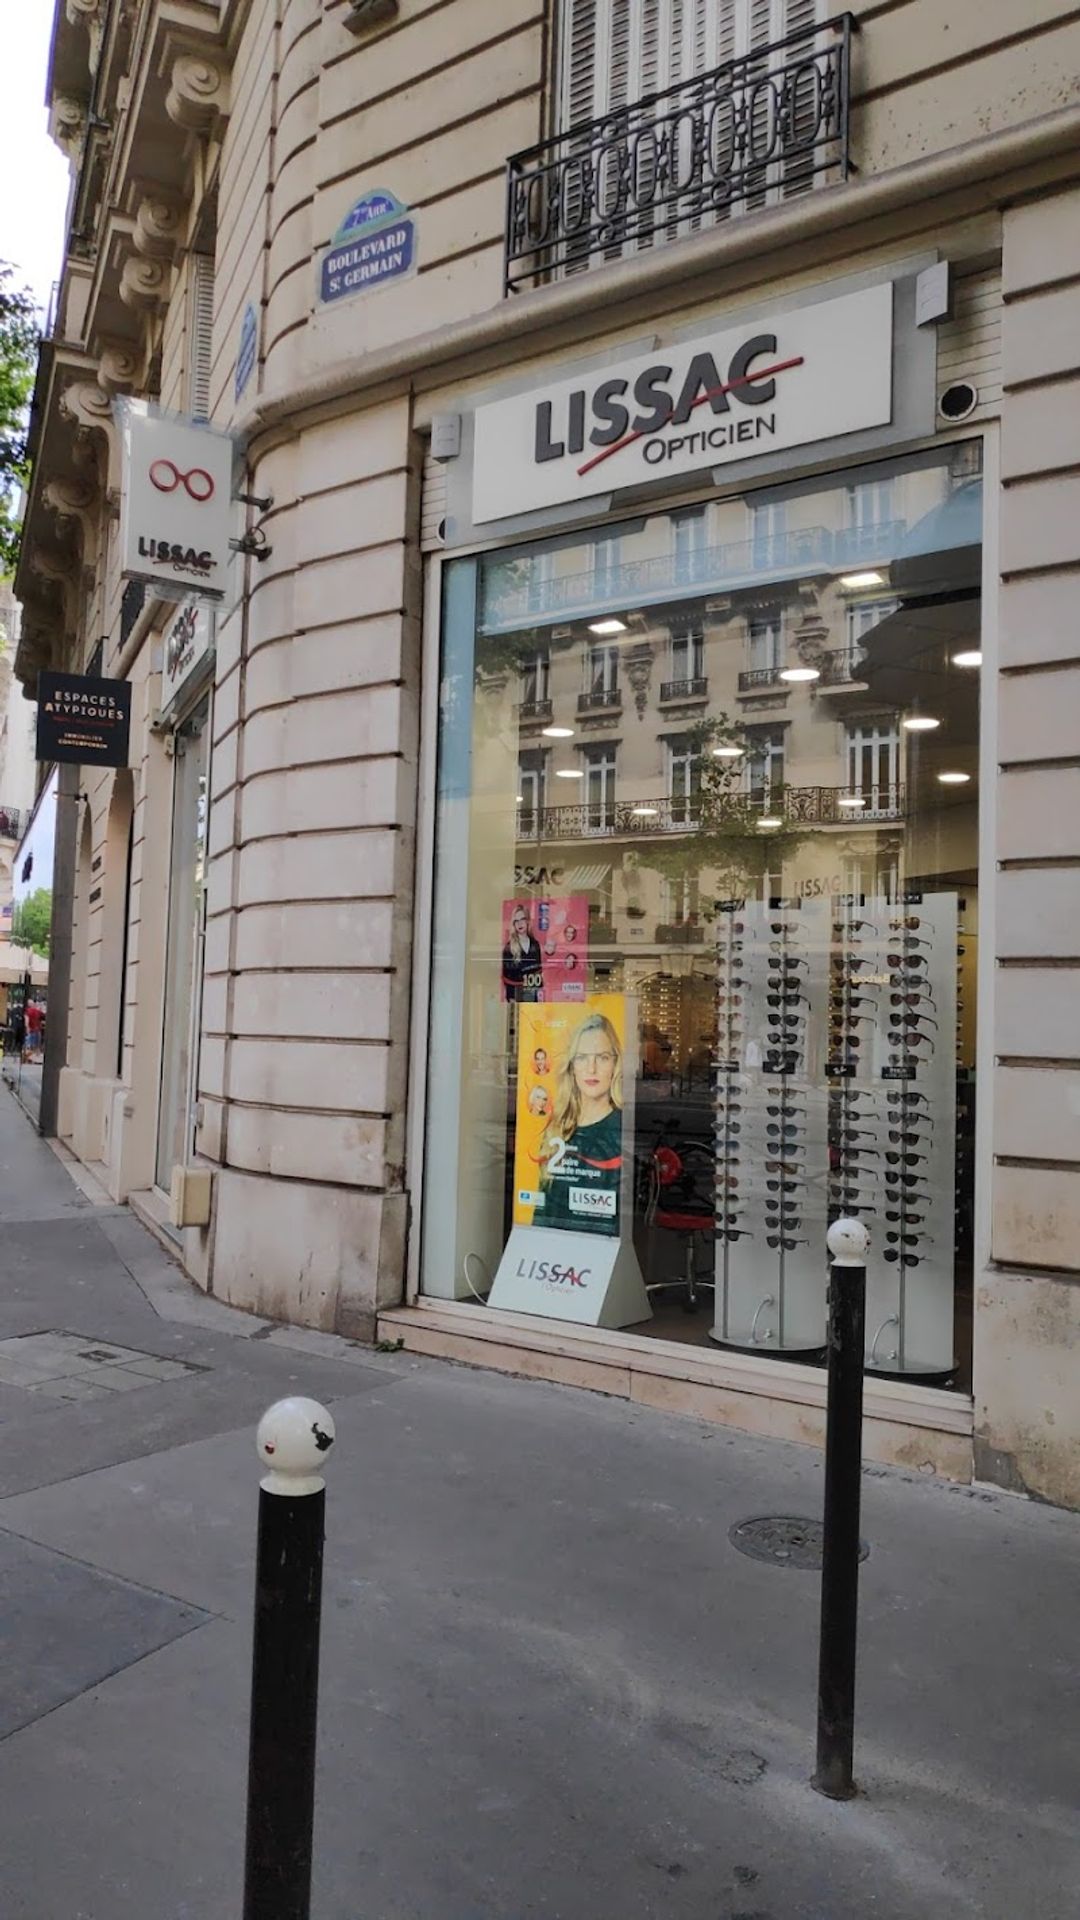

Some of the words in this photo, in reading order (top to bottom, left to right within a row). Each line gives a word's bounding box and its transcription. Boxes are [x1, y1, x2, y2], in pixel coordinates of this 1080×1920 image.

[328, 230, 406, 274] BOULEVARD
[344, 252, 402, 287] GERMAIN
[535, 334, 777, 463] LISSAC
[643, 414, 775, 464] OPTICIEN
[138, 536, 211, 570] LISSAC
[45, 702, 124, 720] ATYPIQUES
[55, 691, 115, 706] ESPACES
[573, 1192, 612, 1207] LISSAC
[516, 1258, 591, 1288] LISSAC
